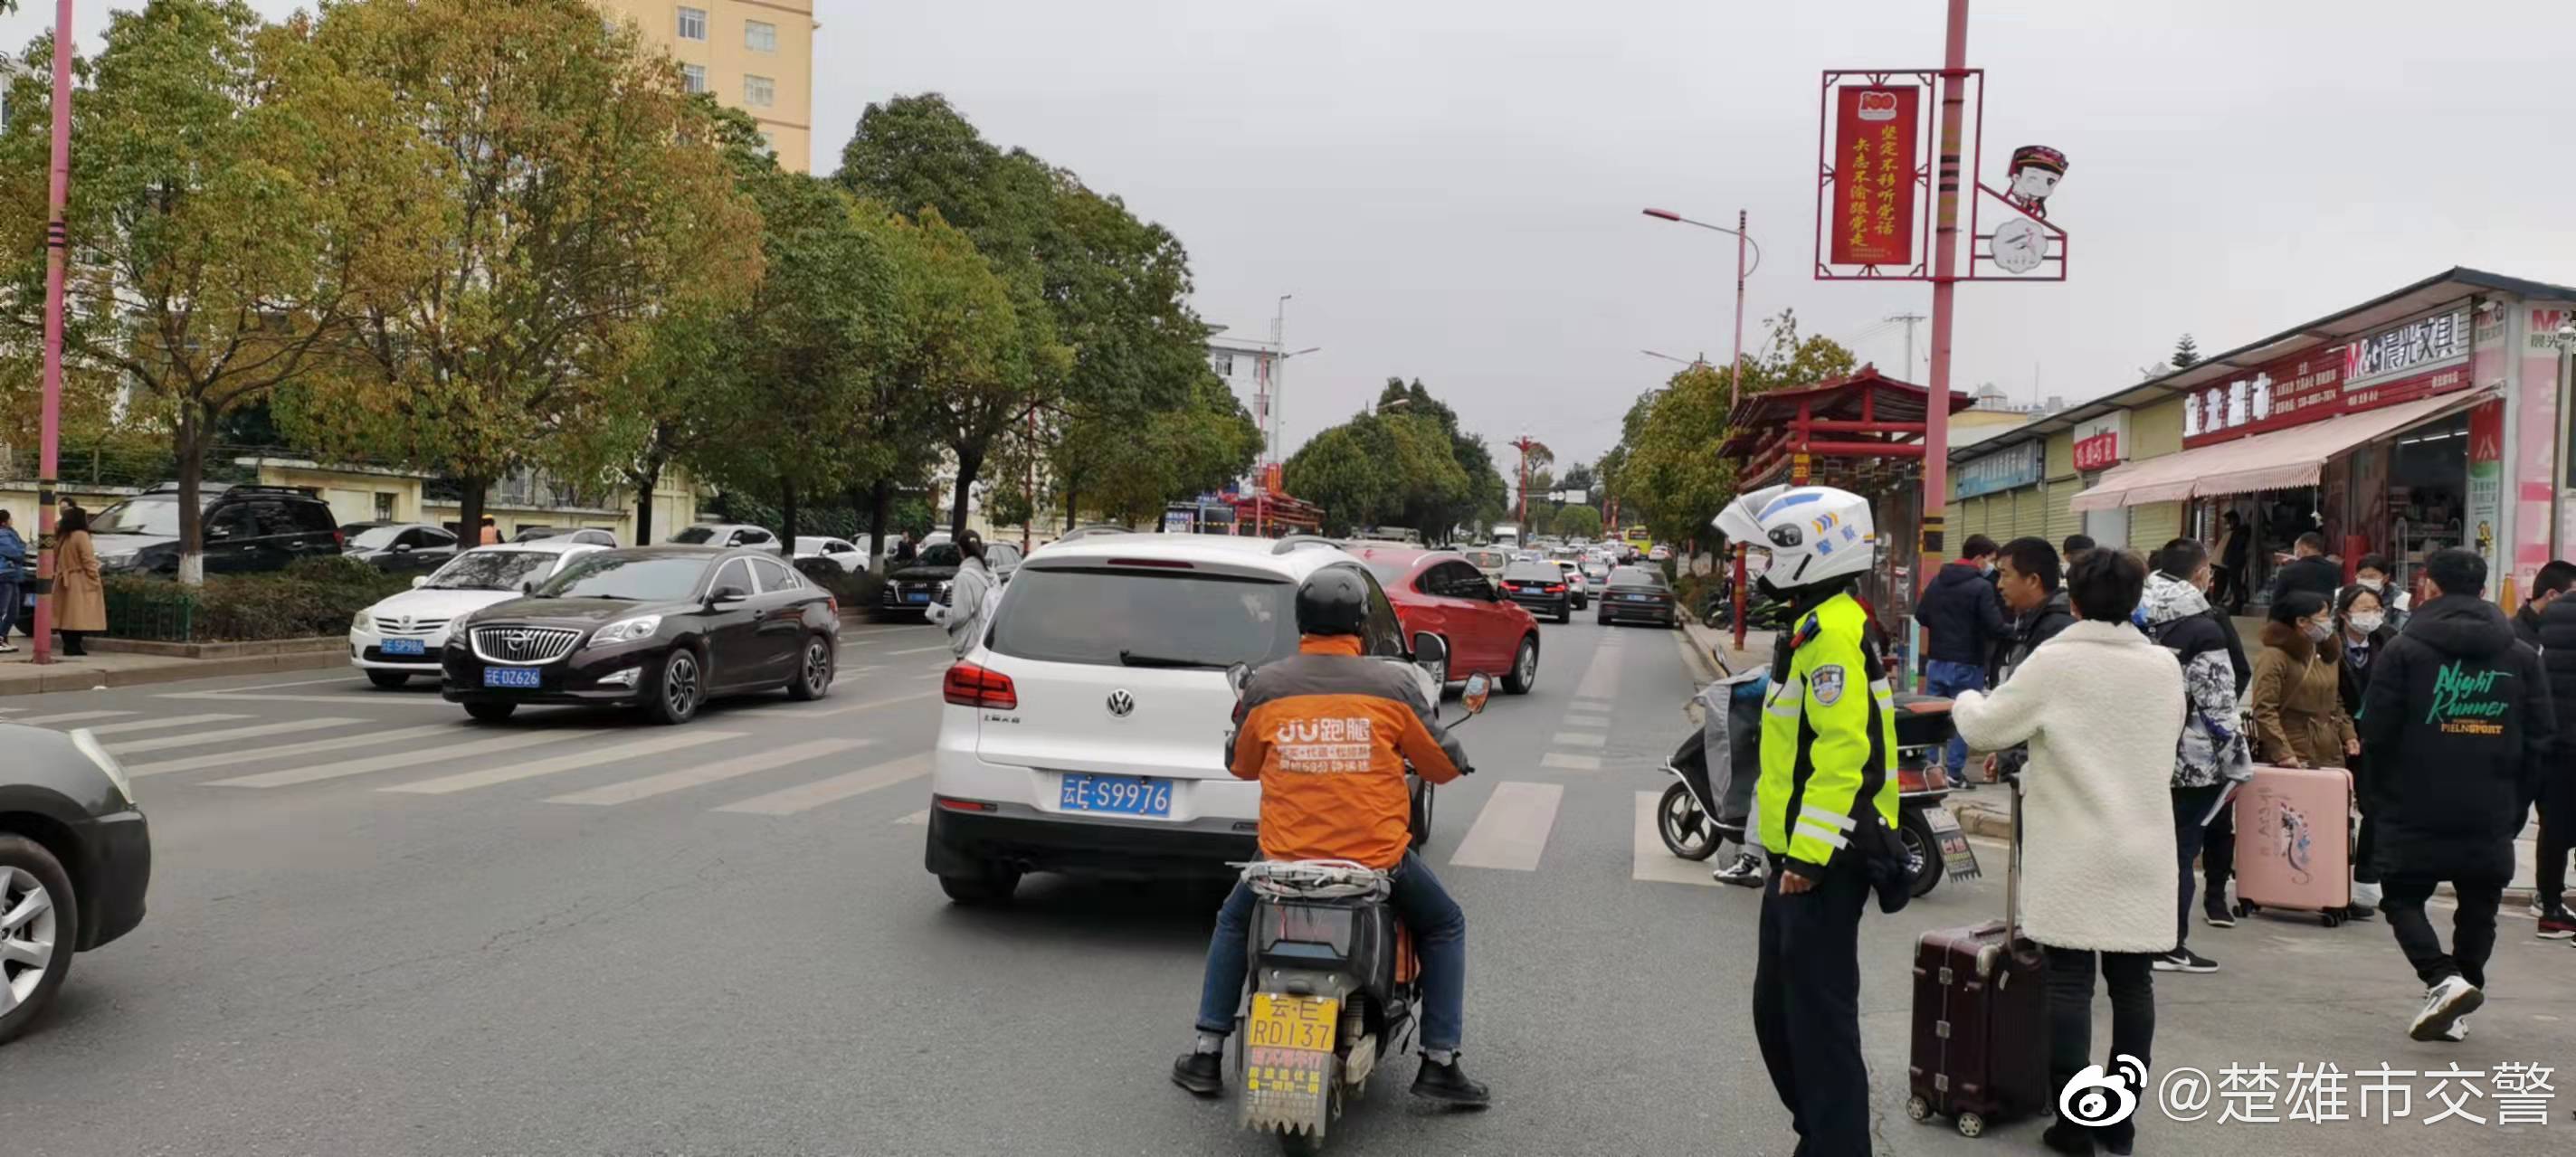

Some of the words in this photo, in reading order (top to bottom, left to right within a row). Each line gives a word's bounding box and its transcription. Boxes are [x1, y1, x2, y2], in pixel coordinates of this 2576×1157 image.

[1874, 124, 1898, 235] 坚定不移听党话
[2434, 659, 2514, 698] Night
[1254, 1020, 1331, 1049] RD137
